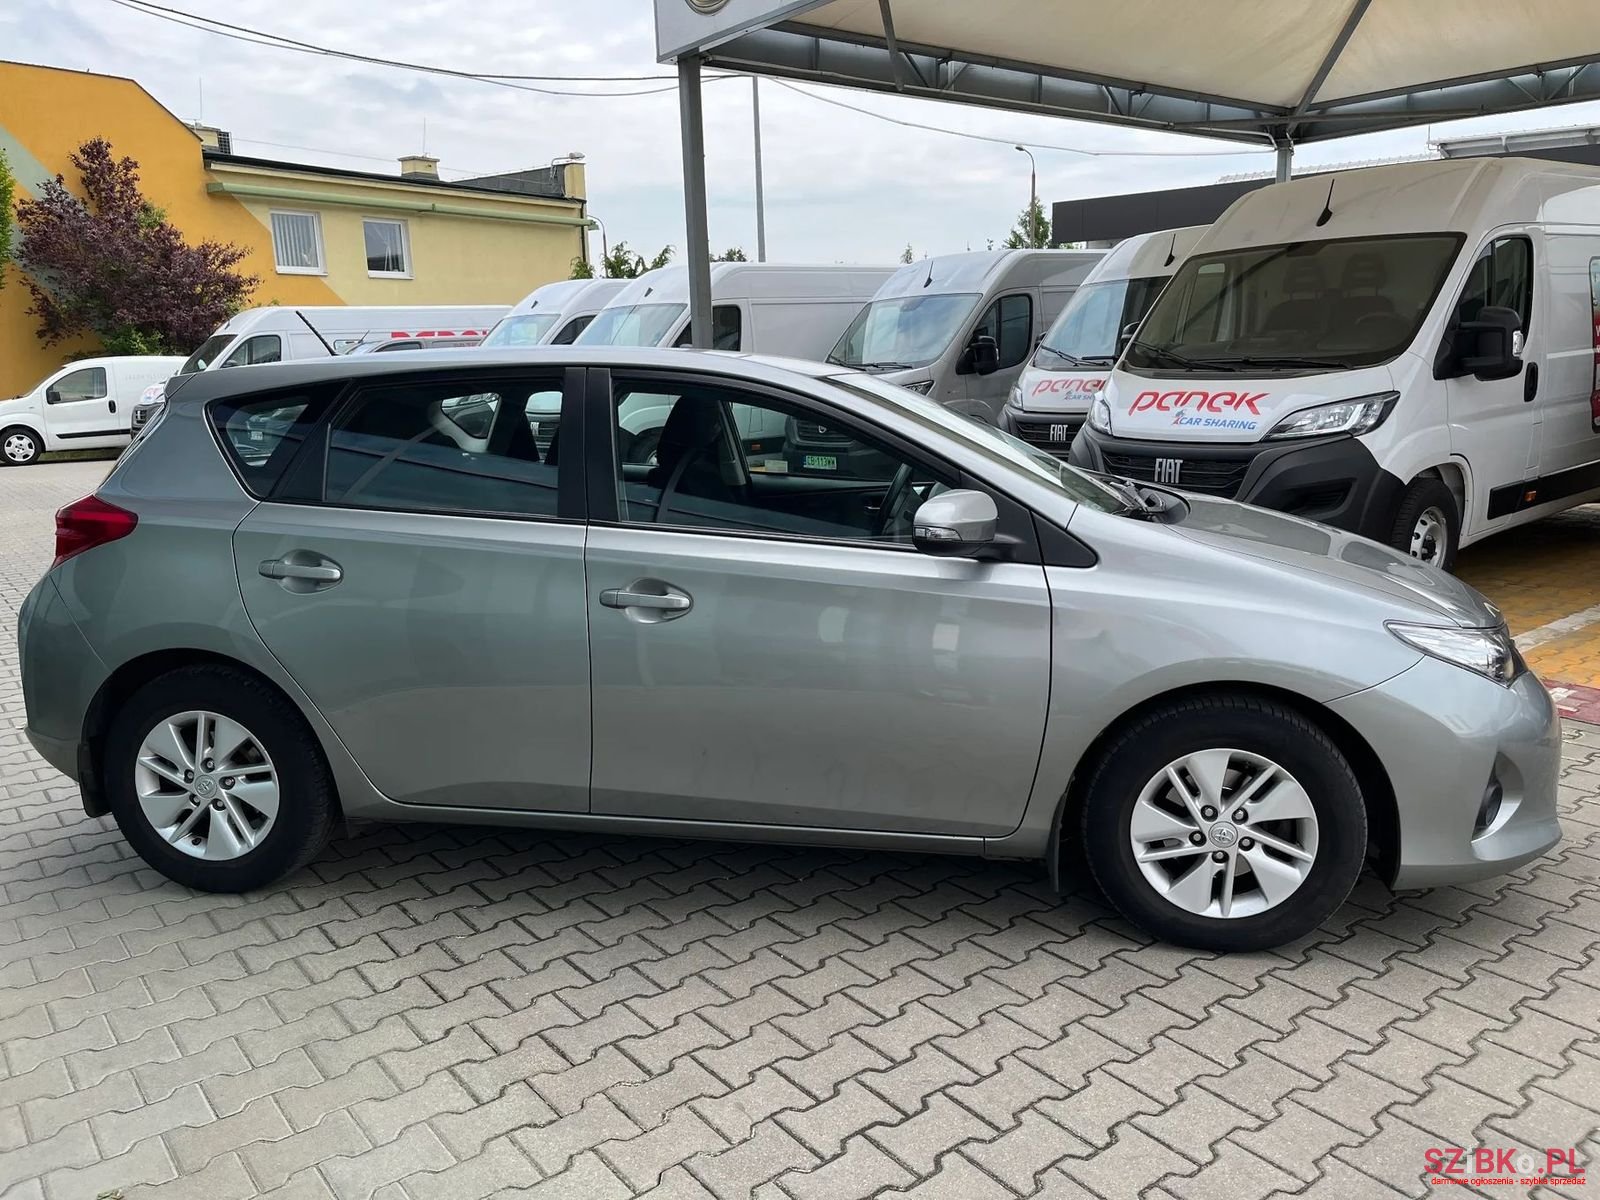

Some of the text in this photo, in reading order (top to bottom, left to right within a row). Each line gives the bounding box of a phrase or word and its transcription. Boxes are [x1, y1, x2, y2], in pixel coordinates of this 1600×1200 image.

[1180, 417, 1257, 430] CAR SHARING
[1050, 424, 1068, 441] FIAT
[1154, 458, 1184, 483] FIAT
